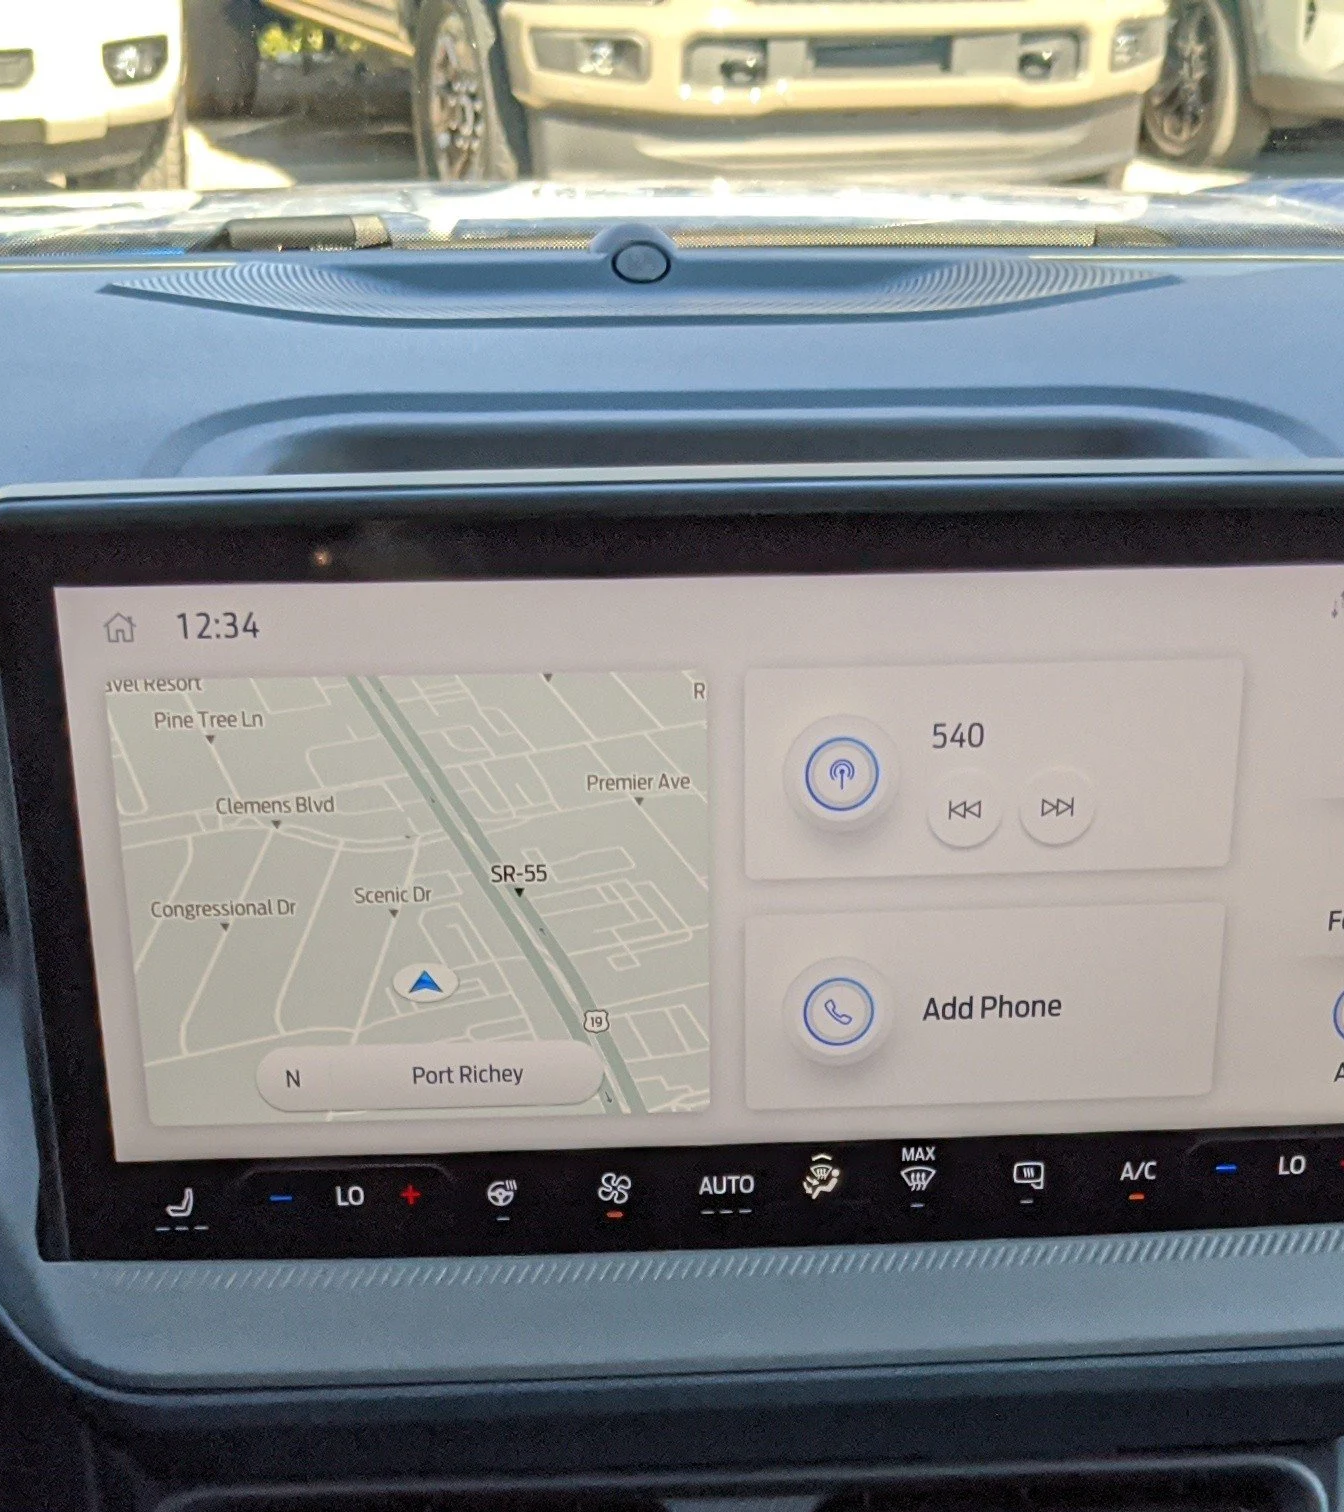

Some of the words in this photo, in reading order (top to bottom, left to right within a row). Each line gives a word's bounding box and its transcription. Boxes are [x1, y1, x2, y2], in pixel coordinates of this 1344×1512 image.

[176, 611, 261, 641] 12:34
[144, 678, 202, 692] Resort
[154, 711, 194, 730] Pine
[197, 711, 238, 729] Tree
[241, 710, 264, 729] Ln
[931, 721, 986, 750] 540
[586, 773, 654, 793] Premier
[657, 772, 691, 791] Ave
[215, 797, 291, 816] Clemens
[294, 795, 336, 814] Blvd
[490, 863, 548, 884] SR-55
[354, 885, 409, 905] Scenic
[411, 884, 432, 903] Dr
[150, 898, 273, 920] Congressional
[276, 898, 297, 916] Dr
[922, 996, 974, 1022] Add
[979, 992, 1063, 1020] Phone
[590, 1015, 604, 1028] 19
[285, 1068, 301, 1088] N
[411, 1065, 457, 1086] Port
[459, 1063, 524, 1088] Richey
[900, 1146, 936, 1162] MAX
[1119, 1160, 1157, 1182] A/C
[1277, 1155, 1307, 1176] LO
[335, 1185, 364, 1206] LO
[699, 1174, 755, 1196] AUTO
